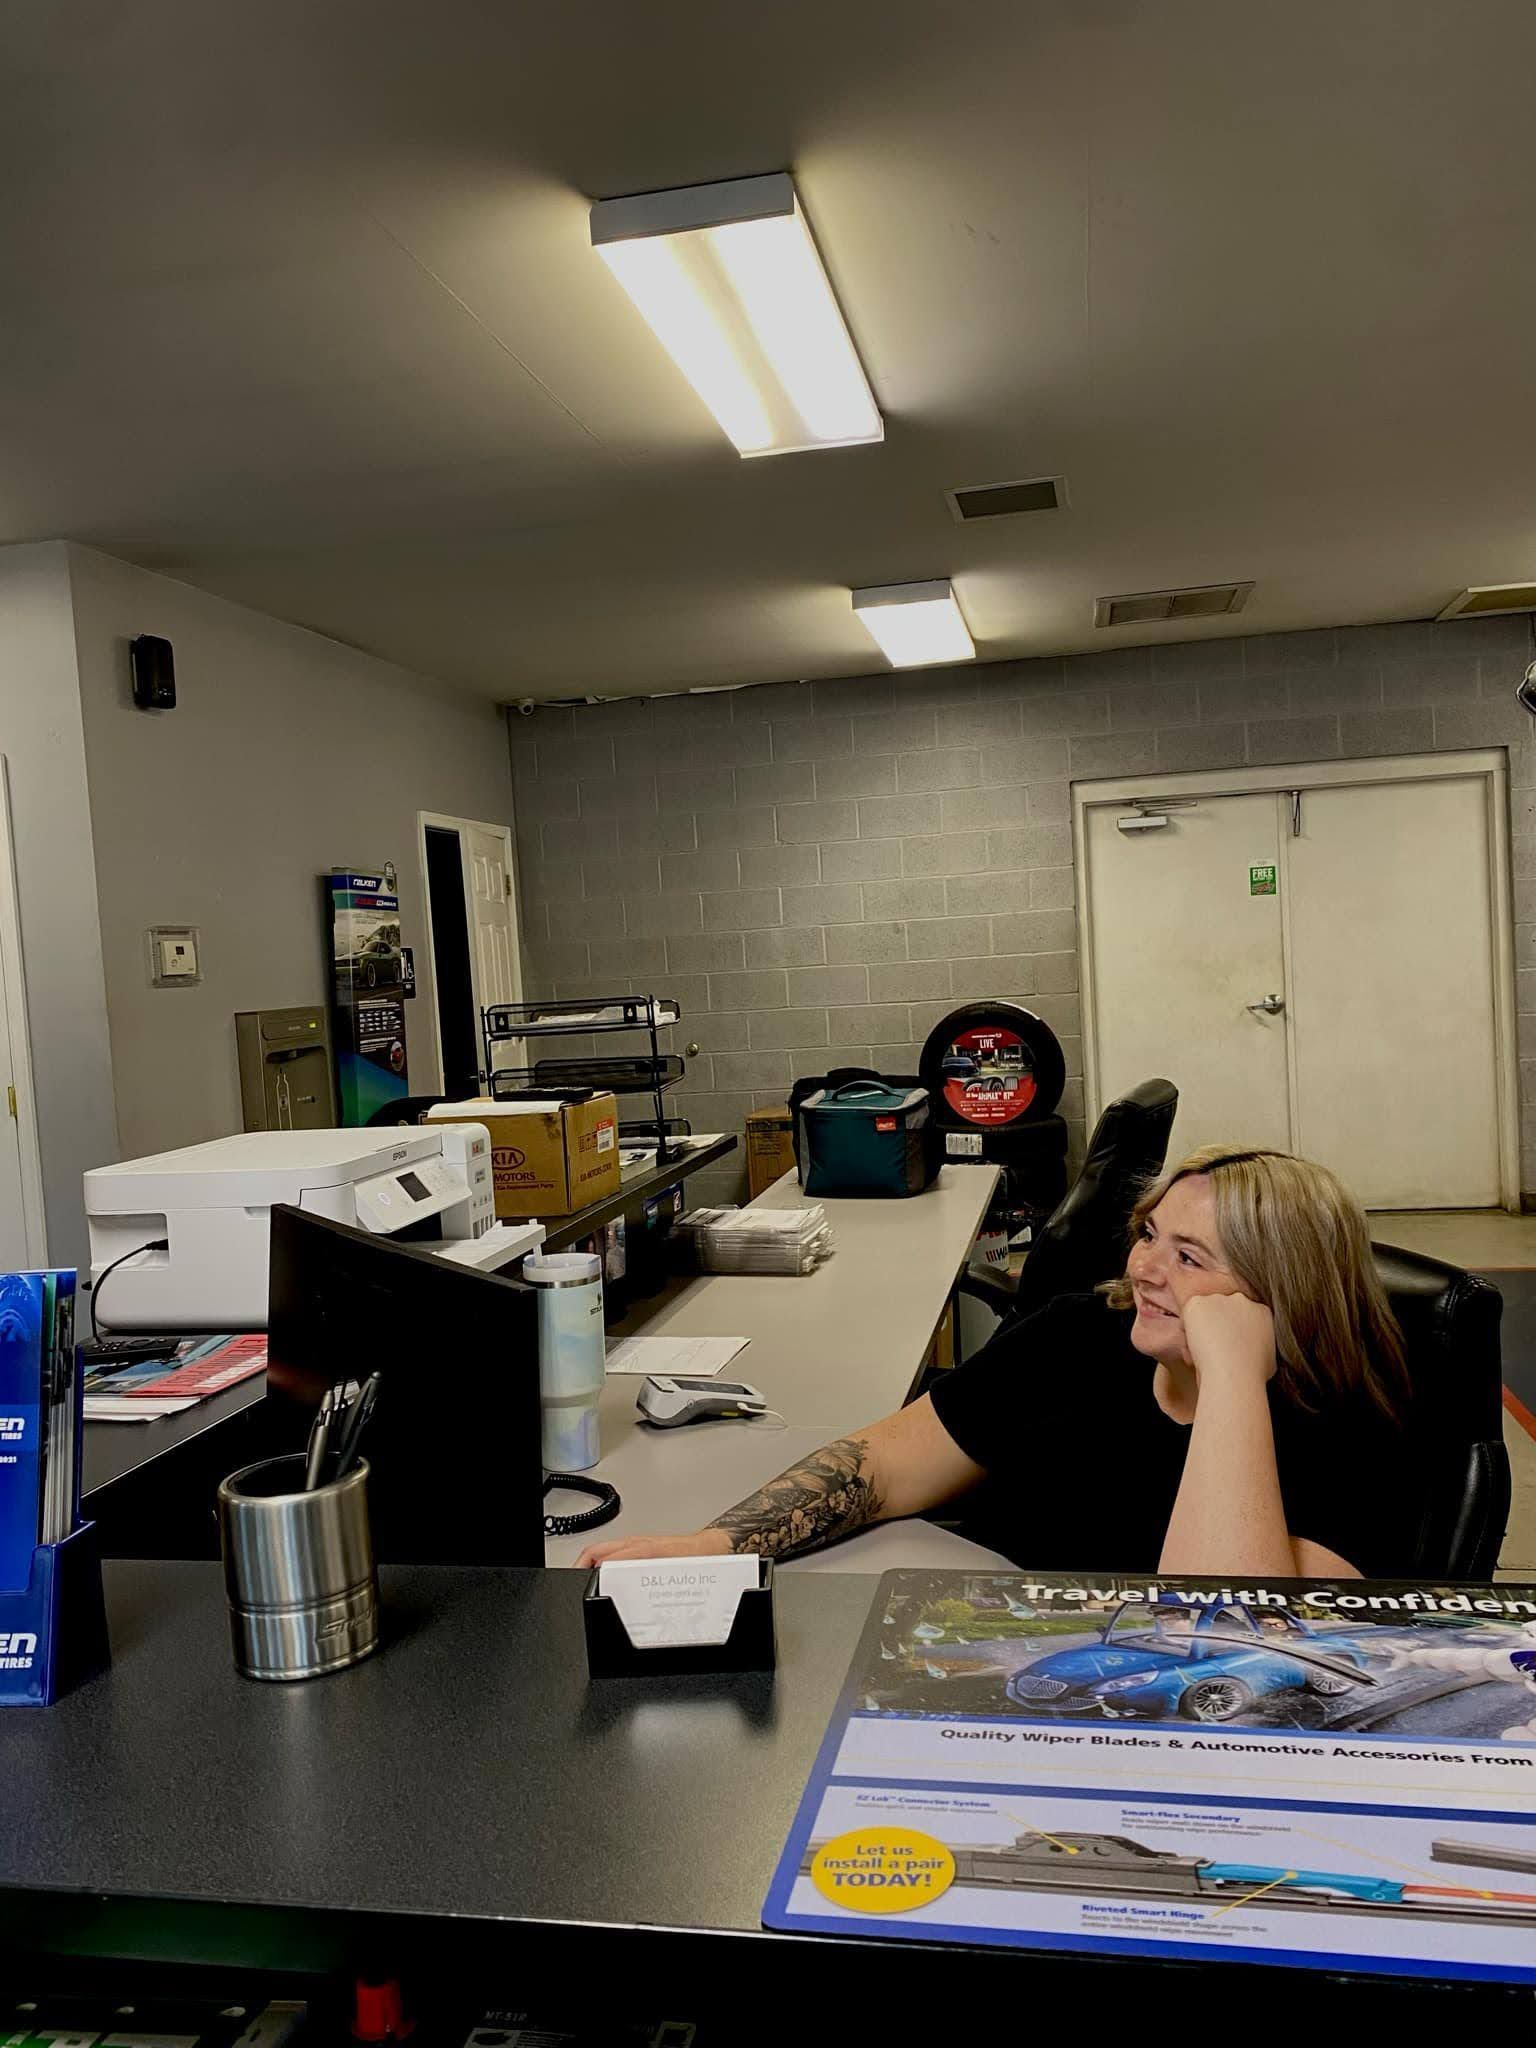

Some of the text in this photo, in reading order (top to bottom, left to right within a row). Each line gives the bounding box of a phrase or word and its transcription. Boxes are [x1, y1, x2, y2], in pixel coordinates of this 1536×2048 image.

[1252, 868, 1273, 879] FREE
[980, 1038, 995, 1049] LIVE
[393, 1150, 407, 1160] EPSON
[494, 1151, 518, 1165] KIA
[496, 1171, 536, 1182] MOTORS
[668, 1574, 697, 1585] Auto
[1021, 1584, 1159, 1603] Travel
[1174, 1588, 1287, 1607] with
[941, 1728, 1534, 1767] Quality Wiper Blades & Automotive Accessories From
[1183, 1813, 1241, 1823] Secondary
[856, 1845, 913, 1856] Let us
[823, 1857, 944, 1871] install a pair
[832, 1873, 932, 1887] TODAY!
[1082, 1904, 1205, 1920] Riveted Smart Hinge
